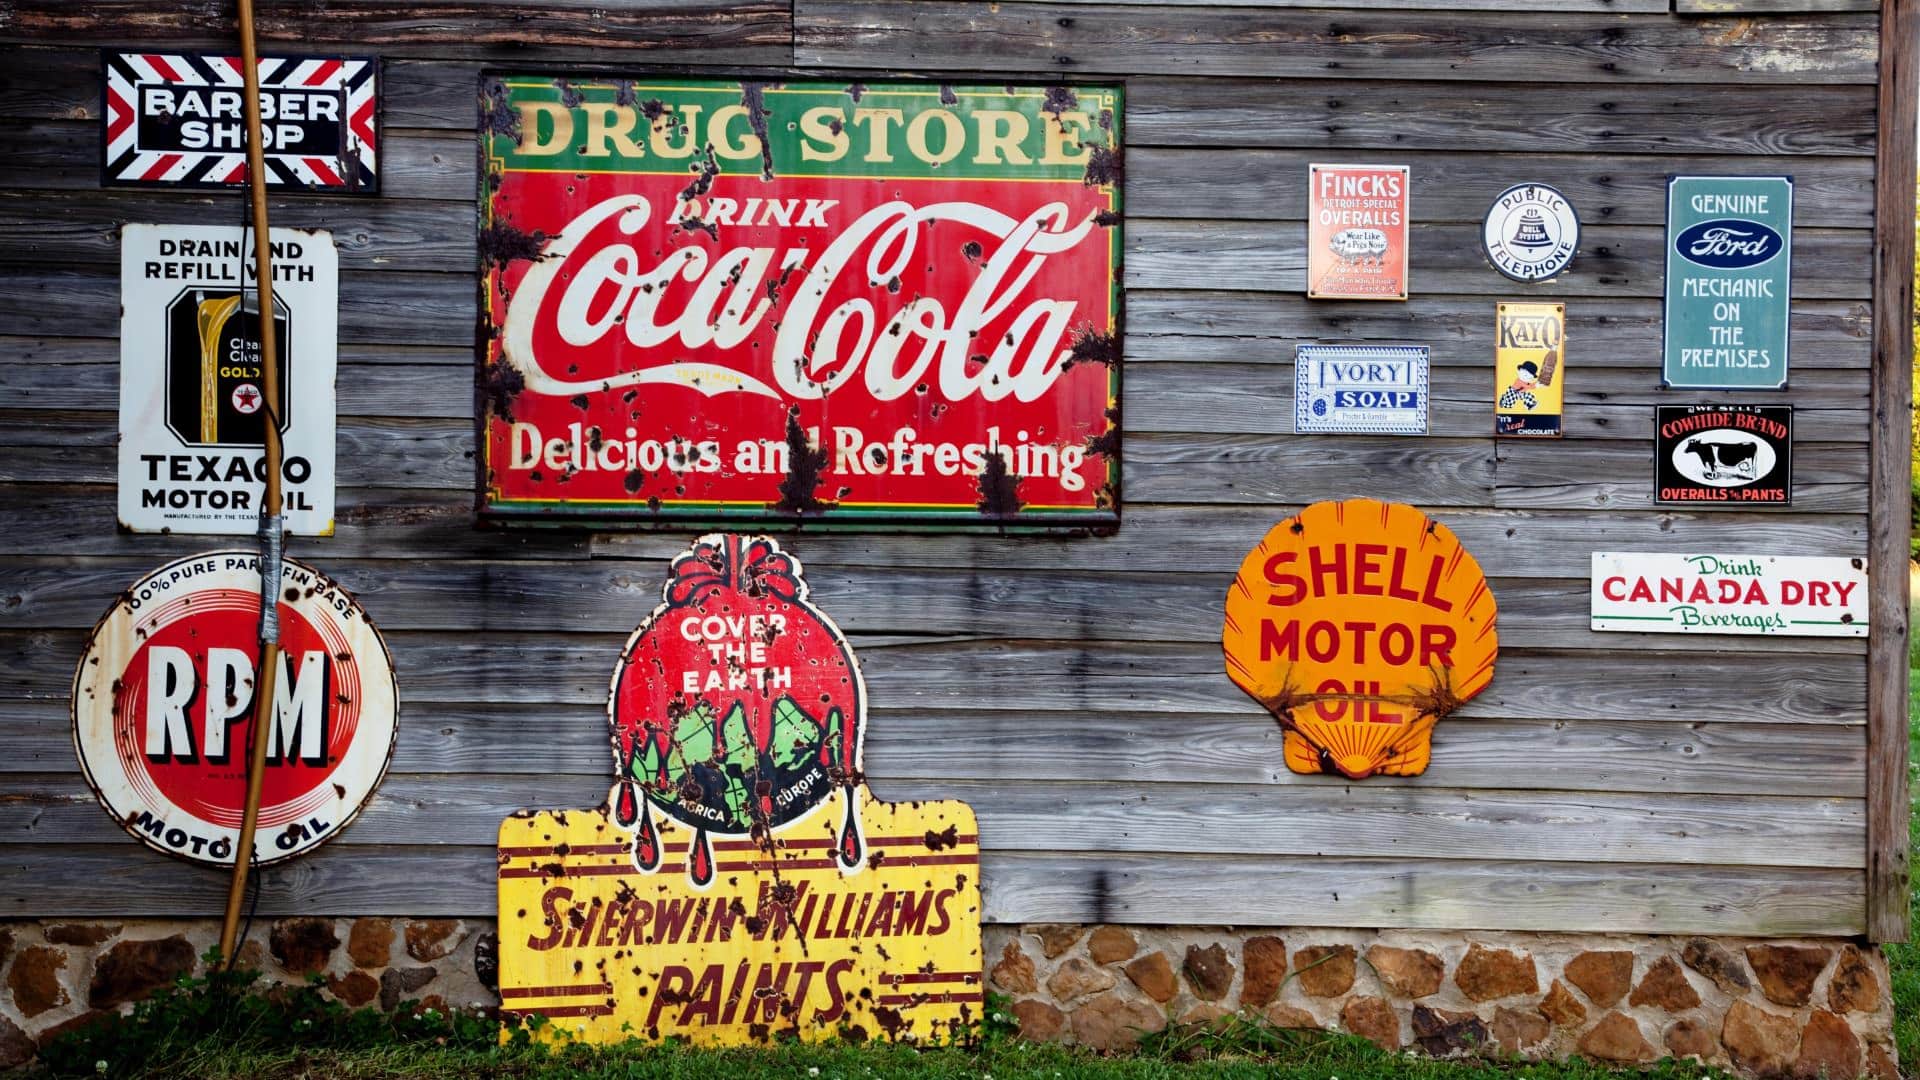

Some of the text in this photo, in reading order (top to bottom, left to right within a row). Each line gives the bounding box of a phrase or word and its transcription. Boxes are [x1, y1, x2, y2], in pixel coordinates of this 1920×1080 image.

[145, 88, 339, 122] BARBER
[512, 101, 1091, 166] DRUG STORE
[1320, 172, 1400, 198] FINCK'S
[666, 197, 839, 229] DRINK
[1501, 190, 1563, 211] PUBLIC
[1691, 195, 1769, 214] GENUINE
[1320, 209, 1400, 226] OVERALLS
[159, 239, 239, 257] DRAIN
[1690, 227, 1769, 256] Ford
[145, 261, 235, 280] REFILL
[1490, 240, 1572, 276] TELEPHONE
[503, 194, 1097, 404] Coca-Cola
[1682, 278, 1774, 297] MECHANIC
[1713, 303, 1740, 321] ON
[230, 338, 262, 350] Clea
[1499, 316, 1560, 350] KAYO
[1709, 326, 1744, 345] THE
[229, 350, 262, 362] Clea
[1681, 348, 1770, 368] PREMISES
[1319, 361, 1404, 388] IVORY
[1341, 391, 1410, 408] SOAP
[1662, 412, 1787, 439] COWHIDE BRAND
[509, 421, 720, 474] Delicious
[142, 489, 249, 509] MOTOR
[1662, 487, 1728, 500] OVERALLS
[1742, 488, 1785, 500] PANTS
[1263, 543, 1453, 613] SHELL
[1688, 555, 1763, 577] Drink
[170, 560, 217, 583] PURE
[224, 558, 310, 586] PARFIN
[313, 579, 354, 621] BASE
[1602, 575, 1858, 607] CANADA DRY
[680, 613, 787, 641] COVER
[1669, 605, 1787, 633] Beverages
[708, 642, 766, 664] THE
[1260, 618, 1456, 668] MOTOR
[682, 667, 792, 693] EARTH
[145, 645, 329, 767] RPM
[1315, 679, 1404, 725] OIL
[677, 798, 725, 823] ARICA
[275, 817, 330, 851] OIL
[646, 958, 854, 1028] PAINTS
